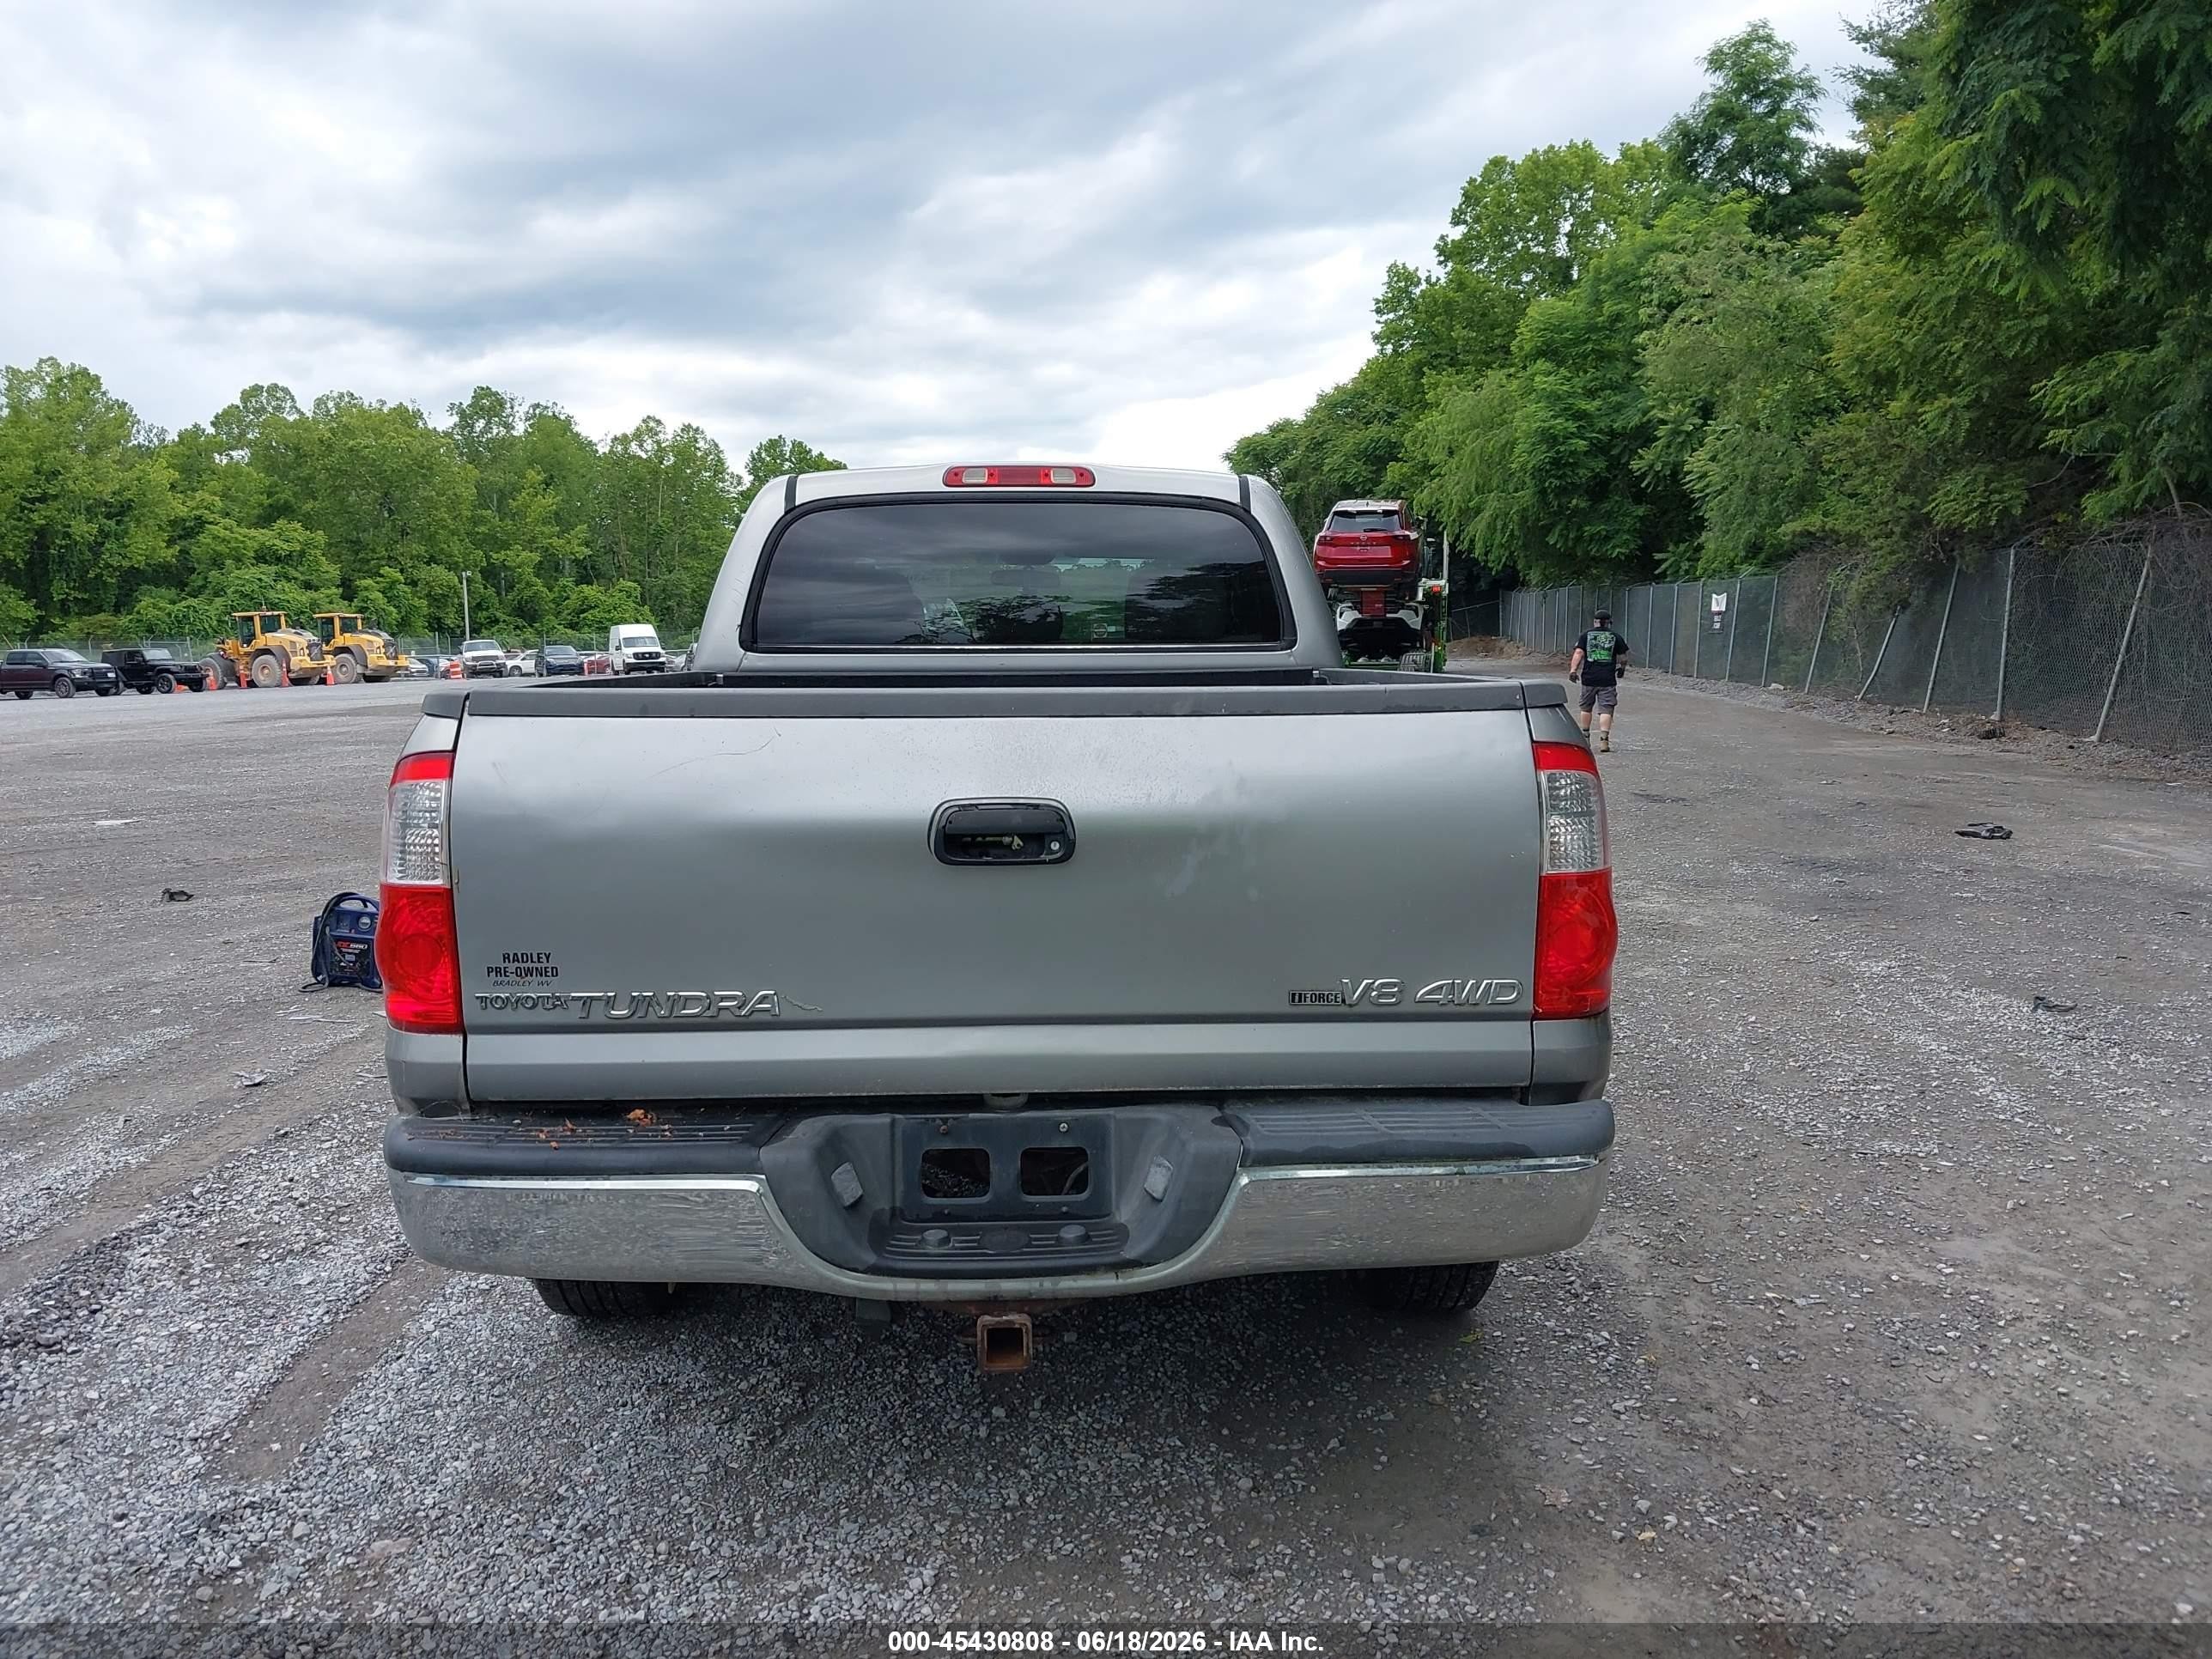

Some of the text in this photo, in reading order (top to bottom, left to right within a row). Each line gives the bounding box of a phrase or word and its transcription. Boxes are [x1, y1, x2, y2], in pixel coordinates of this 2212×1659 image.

[502, 952, 552, 964] RADLEY
[486, 966, 559, 978] PRE-OWNED
[1341, 978, 1405, 1007] V8
[1414, 979, 1523, 1006] 4WD
[474, 989, 779, 1019] TOYOTA TUNDRA
